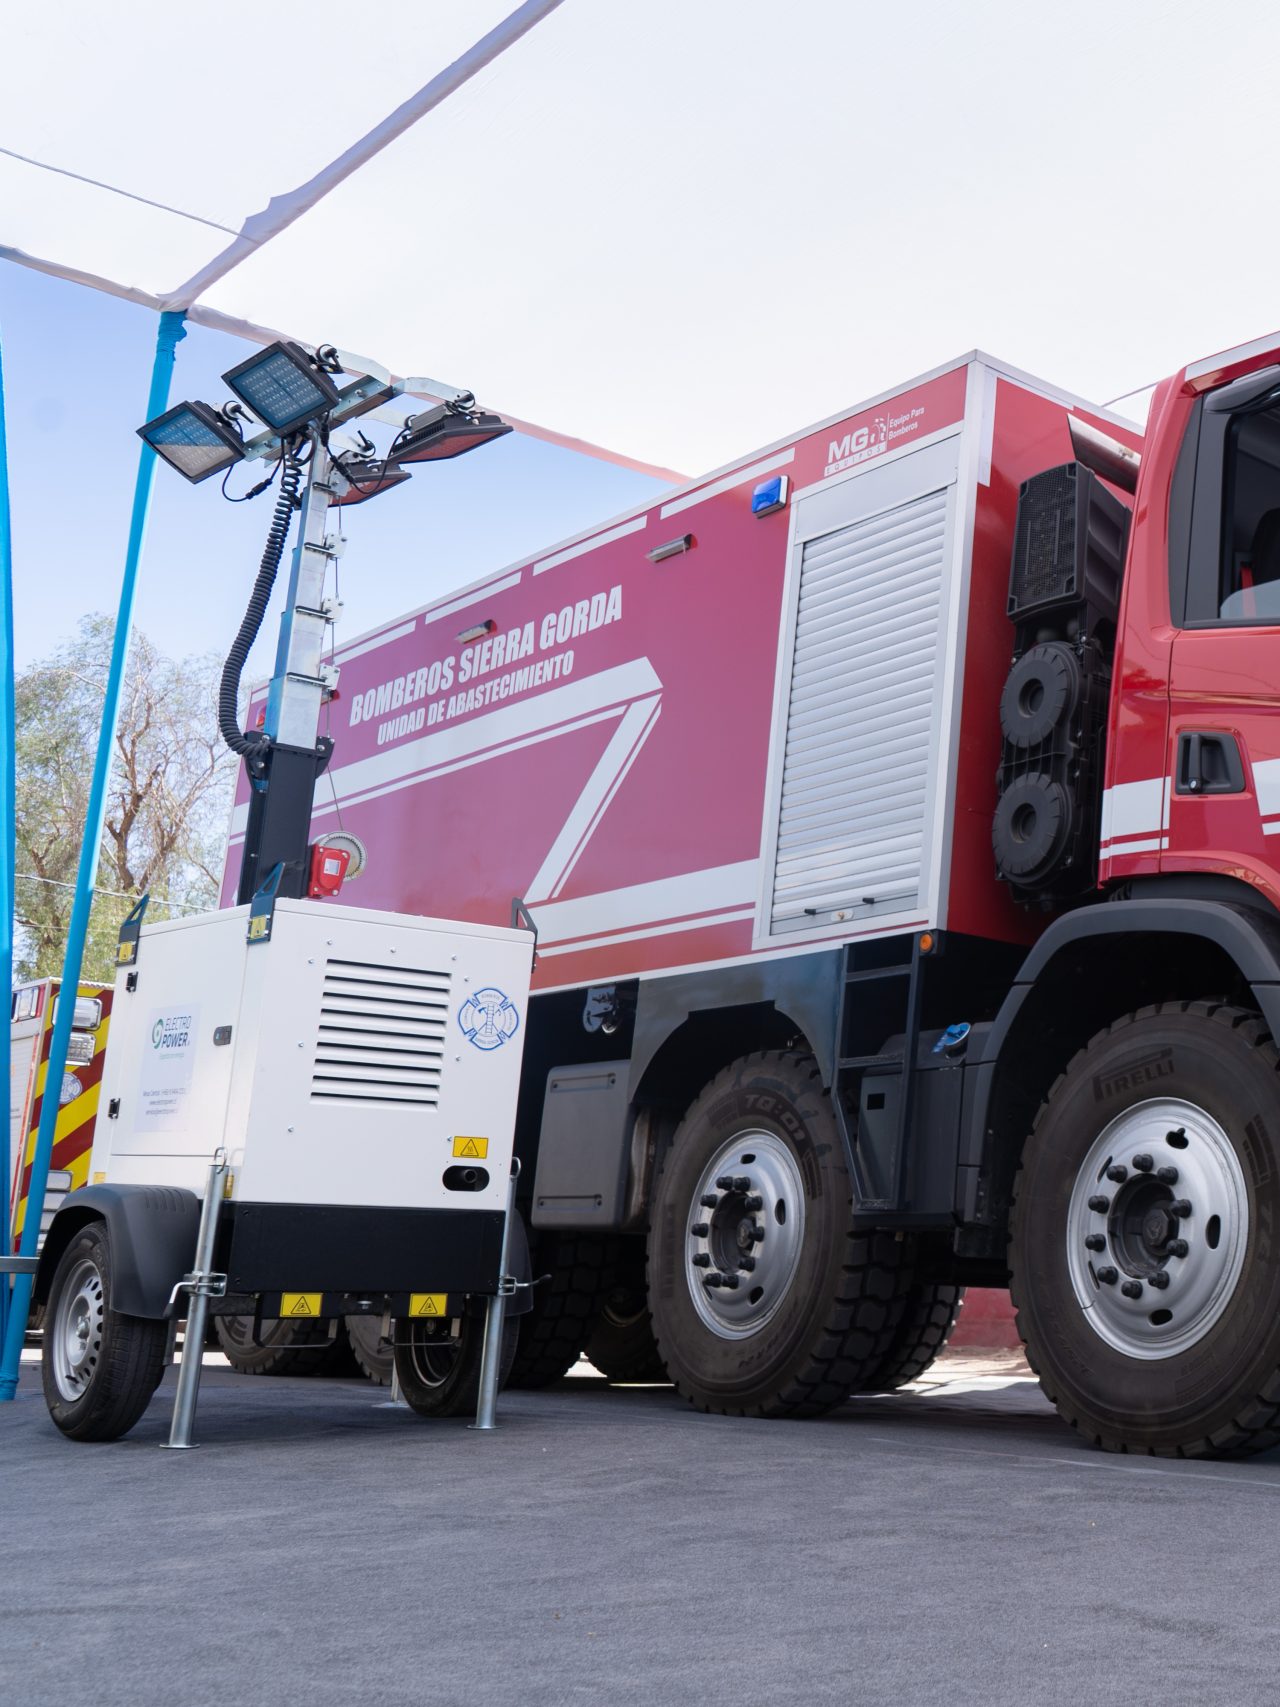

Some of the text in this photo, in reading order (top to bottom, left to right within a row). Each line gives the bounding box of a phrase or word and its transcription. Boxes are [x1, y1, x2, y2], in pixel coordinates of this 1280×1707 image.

[888, 421, 918, 440] Bomberos
[889, 407, 925, 429] Equipo Para
[826, 444, 881, 474] EQUIPOS
[349, 584, 623, 728] BOMBEROS SIERRA GORDA
[376, 650, 575, 746] UNIDAD DE ABASTECIMIENTO
[164, 1015, 193, 1032] ELECTRO
[161, 1032, 188, 1049] POWER
[1092, 1048, 1175, 1102] PIRELLI
